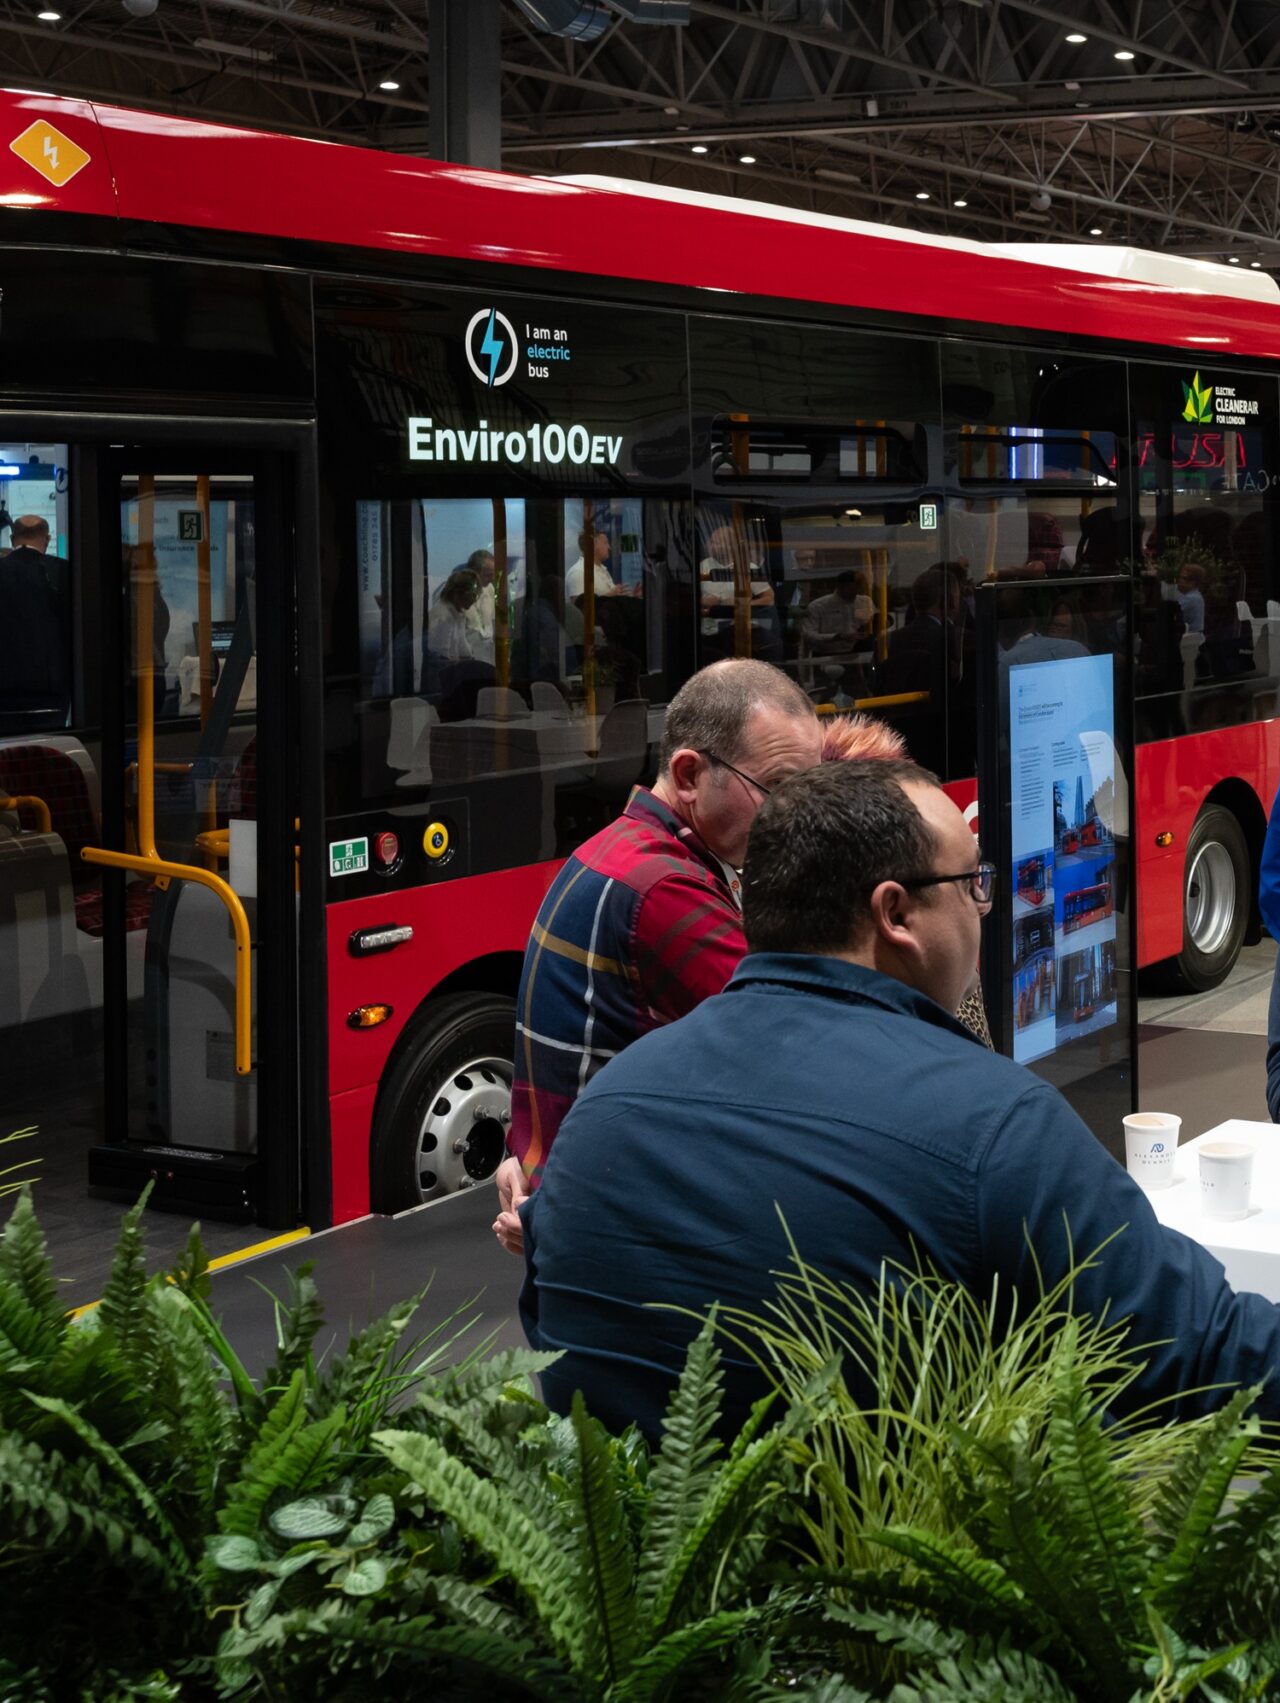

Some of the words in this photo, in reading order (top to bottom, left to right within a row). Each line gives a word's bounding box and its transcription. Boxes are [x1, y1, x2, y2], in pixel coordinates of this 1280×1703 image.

[526, 323, 530, 338] I
[533, 328, 551, 341] am
[554, 330, 568, 341] an
[527, 345, 570, 361] electric
[528, 363, 549, 378] bus
[1215, 386, 1236, 397] ELECTRIC
[1216, 415, 1226, 424] FOR
[1226, 416, 1246, 425] LONDON
